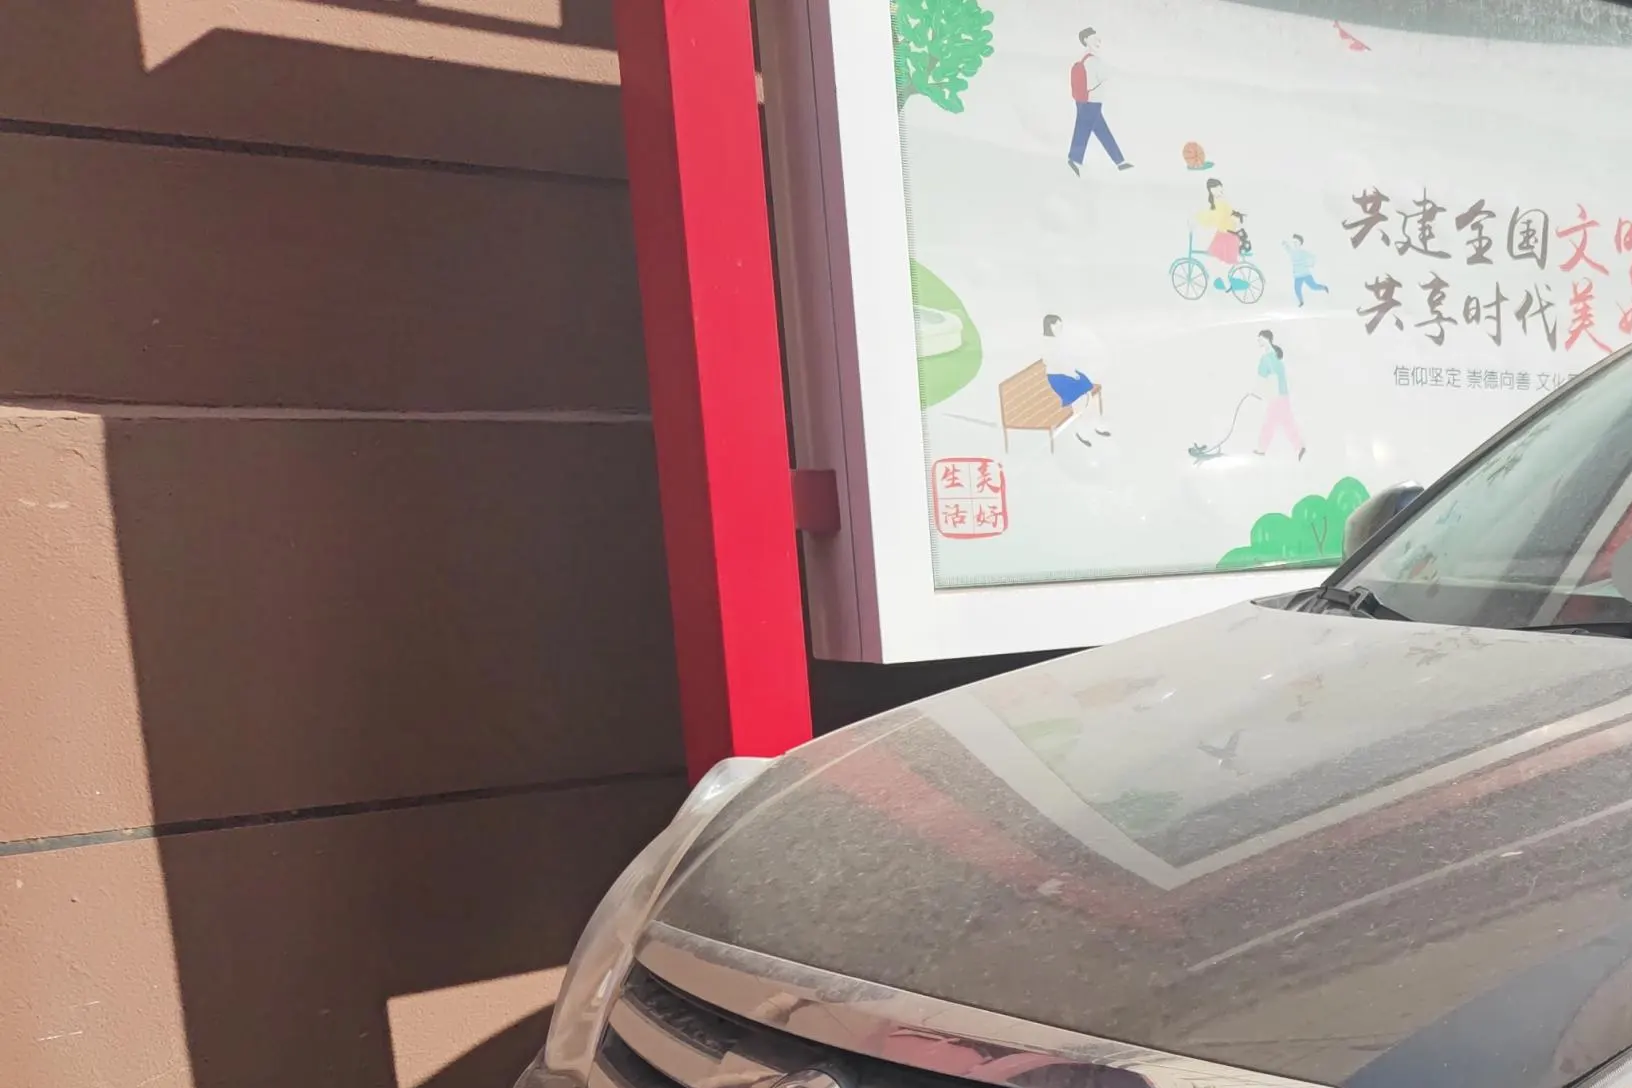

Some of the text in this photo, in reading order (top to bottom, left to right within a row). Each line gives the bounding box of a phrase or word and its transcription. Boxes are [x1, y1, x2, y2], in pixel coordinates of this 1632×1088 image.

[1393, 366, 1461, 388] 信仰坚定
[1466, 369, 1531, 391] 崇德向善
